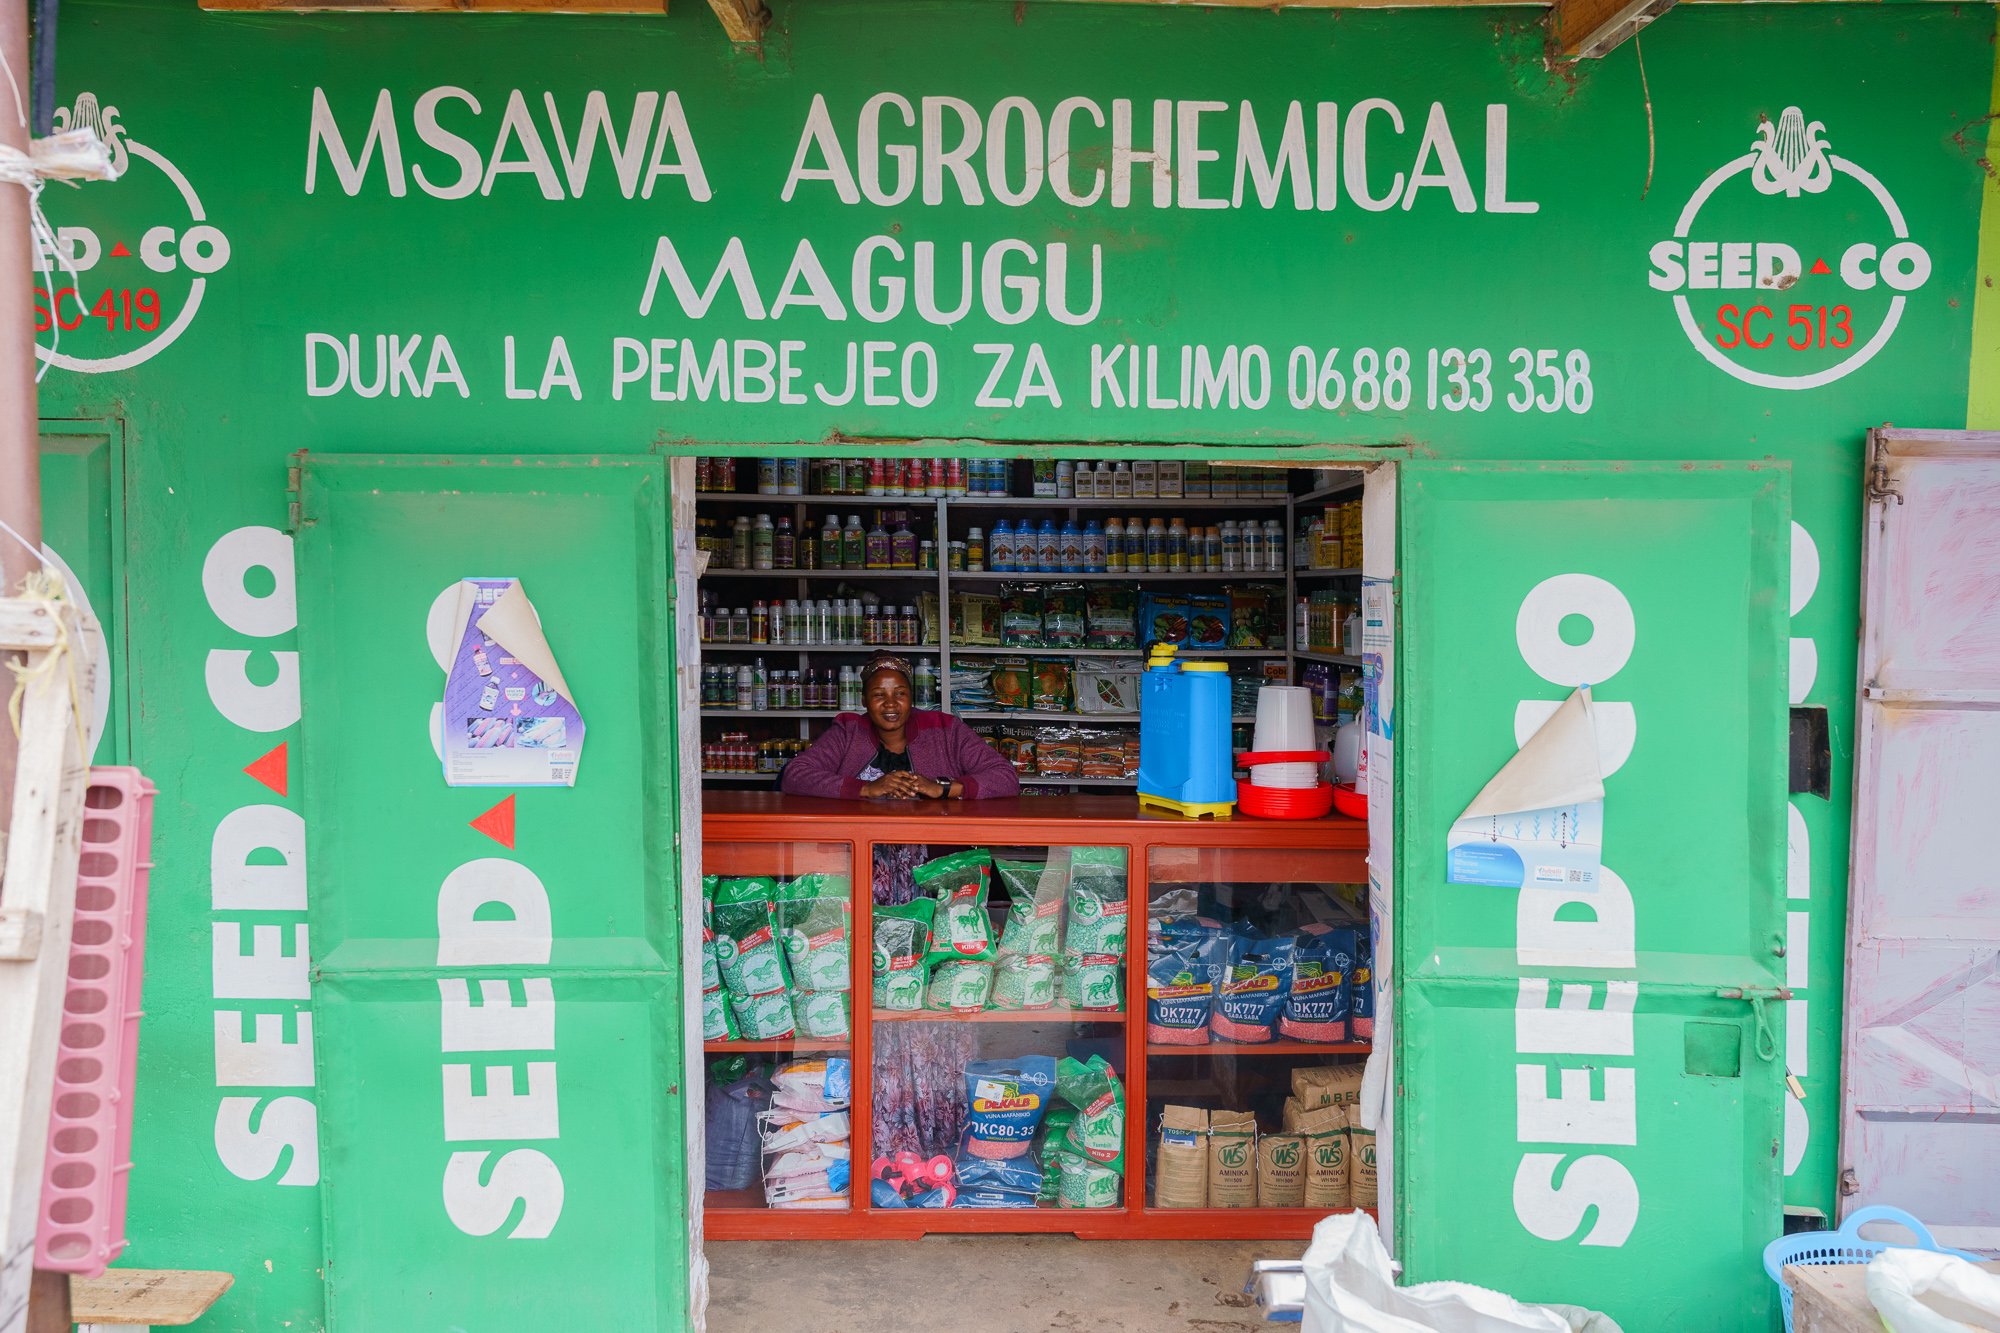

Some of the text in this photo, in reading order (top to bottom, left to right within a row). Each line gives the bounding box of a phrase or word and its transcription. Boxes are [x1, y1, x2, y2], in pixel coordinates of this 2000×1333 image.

[305, 85, 1540, 214] MSAWA AGROCHEMICAL
[139, 225, 231, 274] CO
[1648, 241, 1932, 291] SEED CO
[639, 235, 1103, 328] MAGUGU
[33, 287, 161, 332] SC 419
[1716, 304, 1854, 351] SC 513
[305, 332, 471, 399] DUKA
[504, 335, 583, 401] LA
[972, 342, 1063, 409] ZA
[1090, 343, 1272, 411] KILIMO
[1287, 345, 1412, 412] 0688
[1427, 347, 1493, 413] 133
[1506, 347, 1594, 415] 358
[202, 525, 320, 1187] SEED CO
[1160, 1007, 1202, 1019] DK777
[1224, 1003, 1264, 1016] DK777
[1293, 1002, 1334, 1014] DK777
[436, 857, 565, 1240] SEED
[1512, 864, 1640, 1248] SEED
[984, 1097, 1031, 1110] DEKALB
[971, 1121, 1035, 1136] DKC80-33
[1218, 1169, 1249, 1177] AMINIKA
[1270, 1169, 1300, 1177] AMINIKA
[1315, 1169, 1345, 1177] AMINIKA
